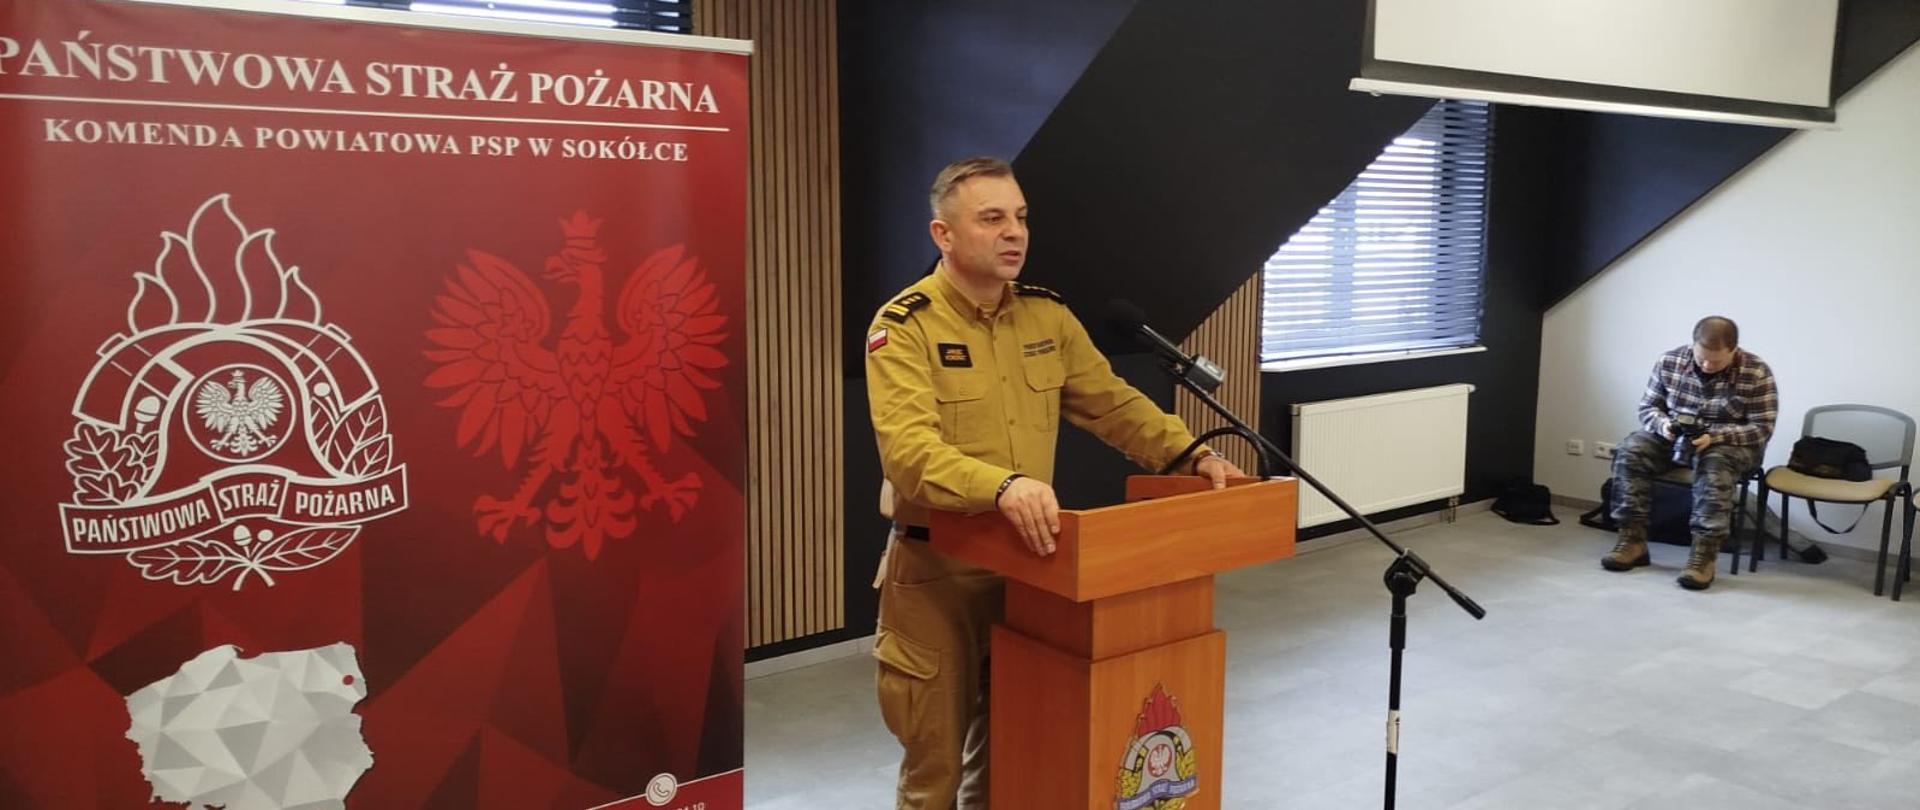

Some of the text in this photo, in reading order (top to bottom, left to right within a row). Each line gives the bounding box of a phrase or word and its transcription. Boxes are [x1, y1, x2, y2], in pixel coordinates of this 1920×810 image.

[0, 30, 720, 114] PAŃSTWOWA STRAŻ POŻARNA
[43, 118, 688, 162] KOMENDA POWIATOWA PSP W SOKÓŁCE
[73, 479, 395, 543] PAŃSTWOWA STRAŻ POŻARNA
